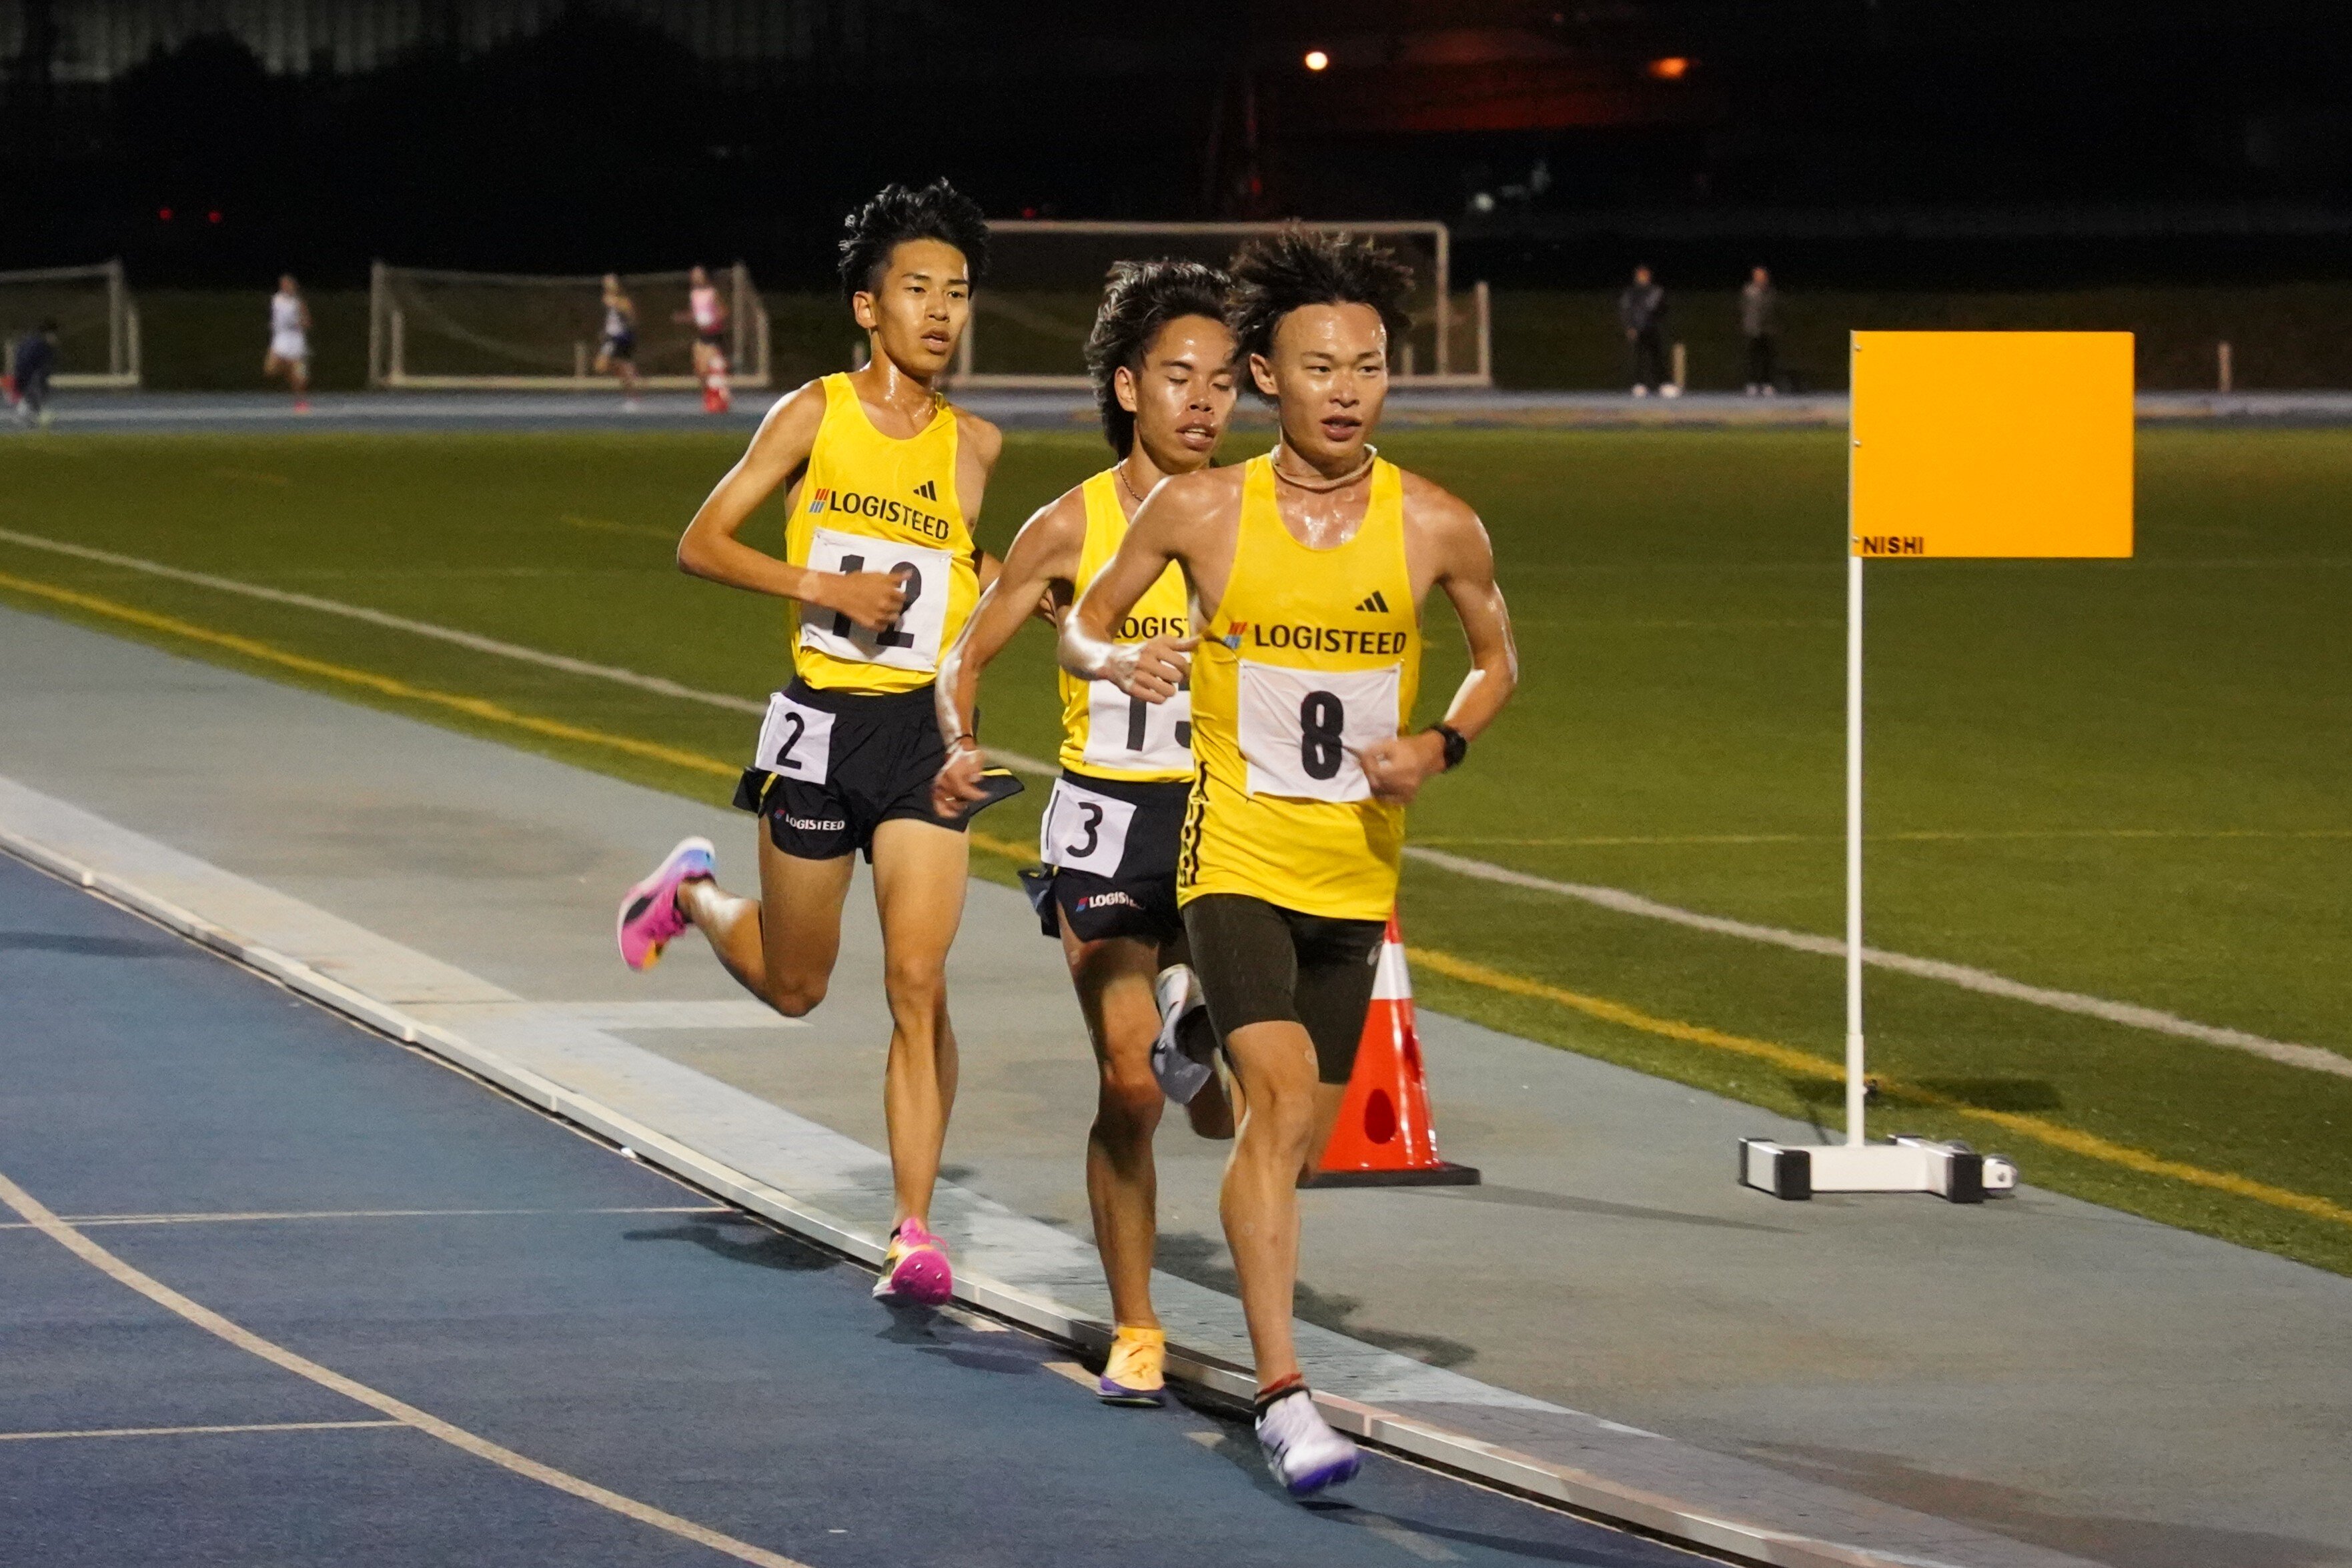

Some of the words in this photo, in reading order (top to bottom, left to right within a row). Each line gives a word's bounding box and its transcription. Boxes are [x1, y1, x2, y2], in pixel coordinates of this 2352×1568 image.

[830, 490, 949, 540] LOGISTEED
[1863, 536, 1924, 554] NISHI
[832, 554, 922, 649] 12
[1117, 616, 1188, 639] OGIS
[1254, 624, 1406, 654] LOGISTEED
[1300, 690, 1344, 780] 8
